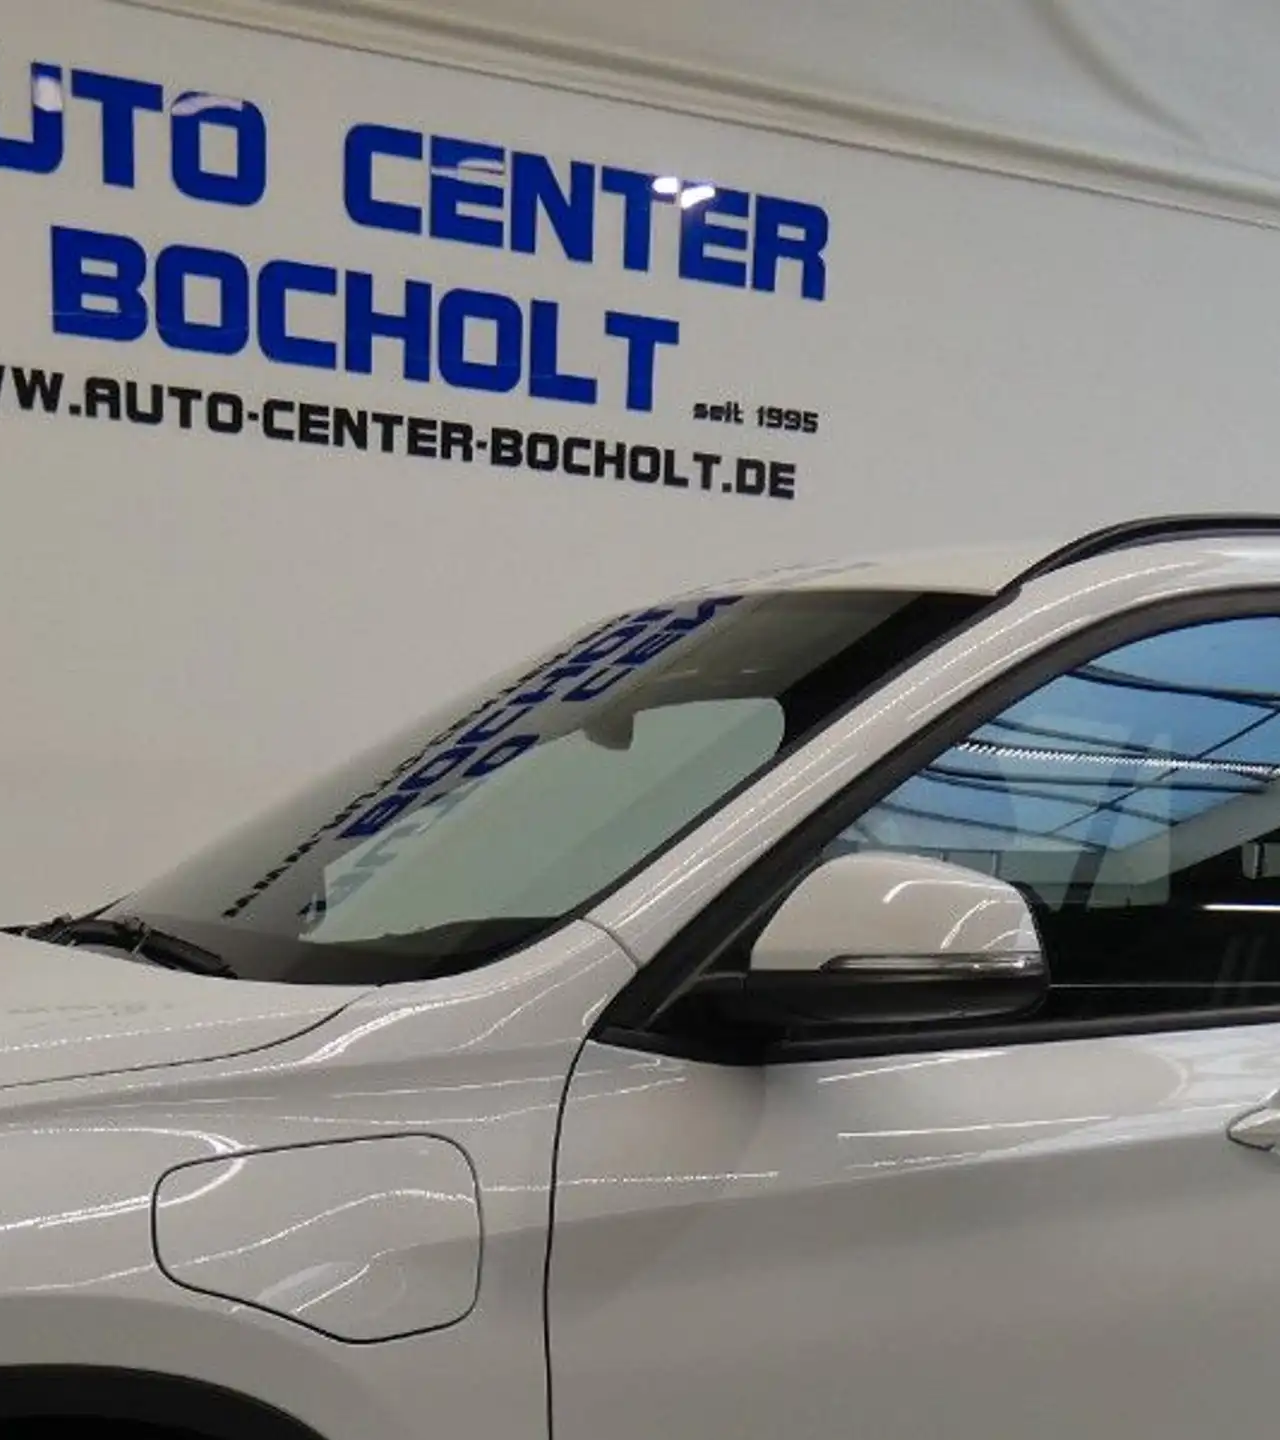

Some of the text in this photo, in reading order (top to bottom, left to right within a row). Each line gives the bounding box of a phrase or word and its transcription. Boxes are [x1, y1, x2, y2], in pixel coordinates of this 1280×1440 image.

[344, 123, 828, 301] CENTER
[51, 225, 679, 412] BOCHOLT
[692, 400, 819, 434] seit 1995
